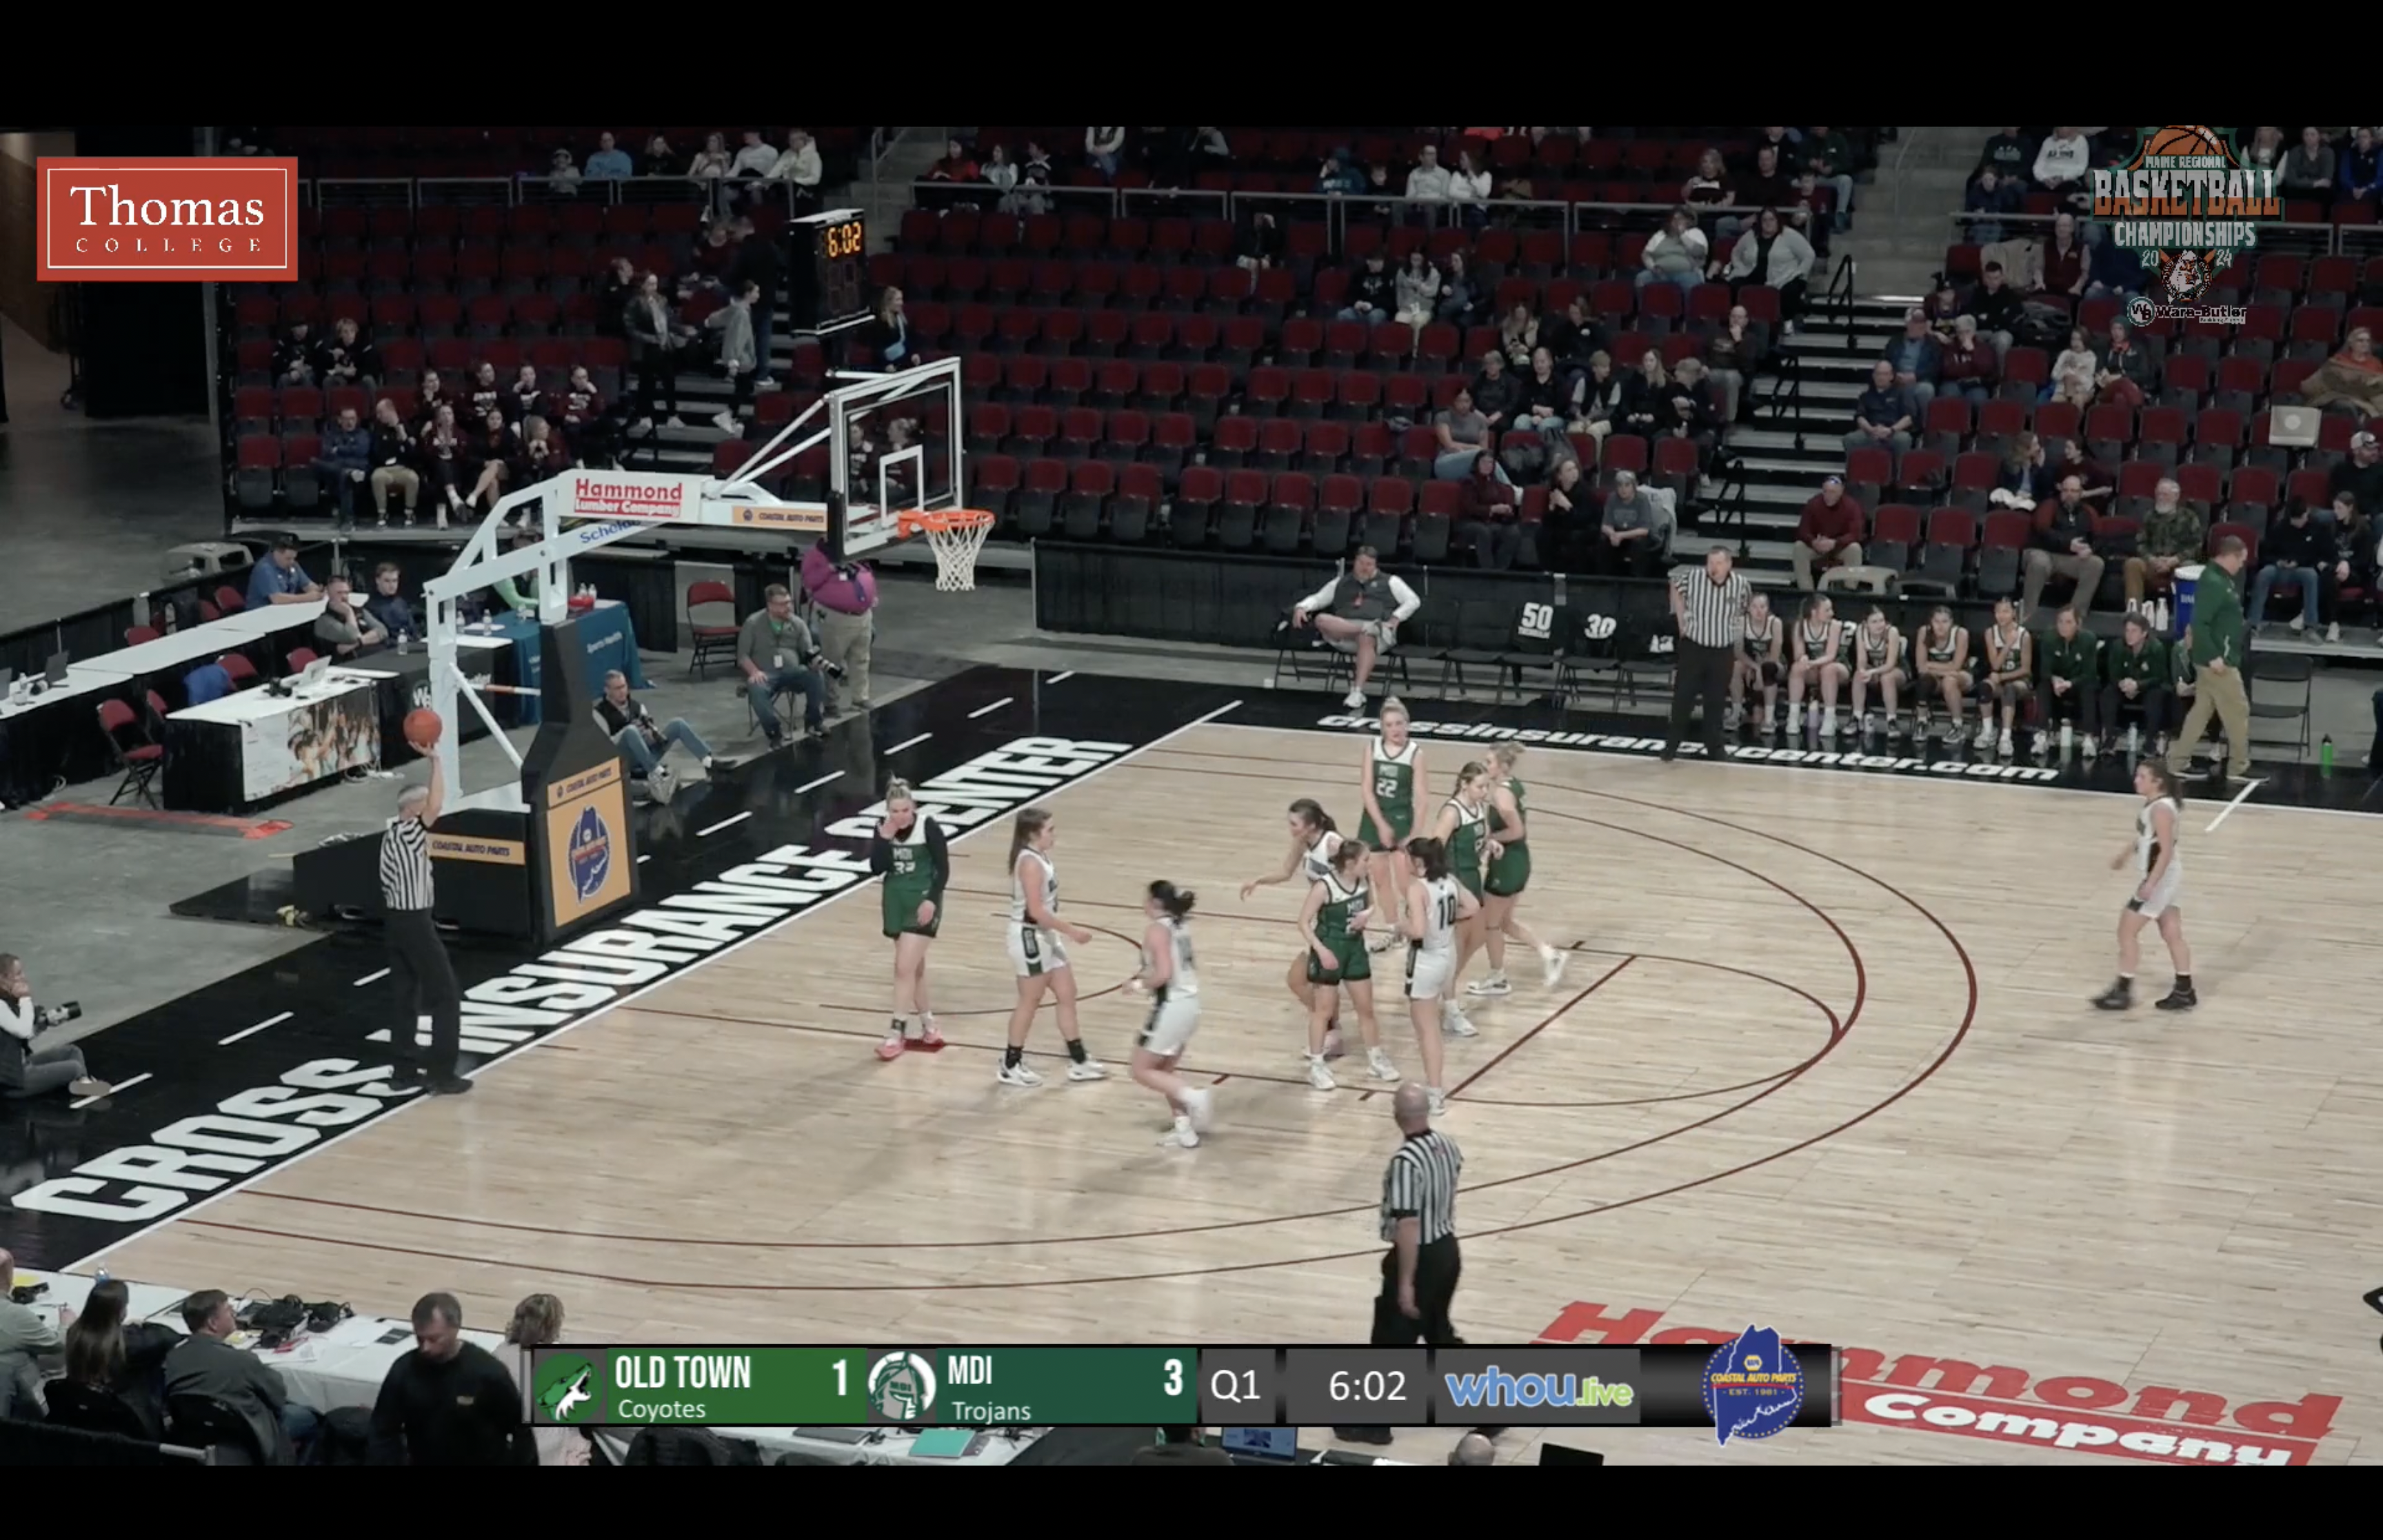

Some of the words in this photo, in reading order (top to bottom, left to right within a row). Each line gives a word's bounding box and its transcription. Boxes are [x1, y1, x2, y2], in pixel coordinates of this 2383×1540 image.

[828, 221, 861, 257] 6:02
[575, 478, 683, 500] Hammond
[574, 496, 619, 512] Lumber
[621, 500, 681, 517] Company
[1522, 602, 1554, 630] 50
[1585, 614, 1617, 639] 30
[1376, 778, 1398, 798] 22
[1438, 893, 1456, 930] 10
[10, 1057, 425, 1222] CROSS
[365, 844, 872, 1055] INSURANCE
[1864, 1392, 2292, 1466] Company
